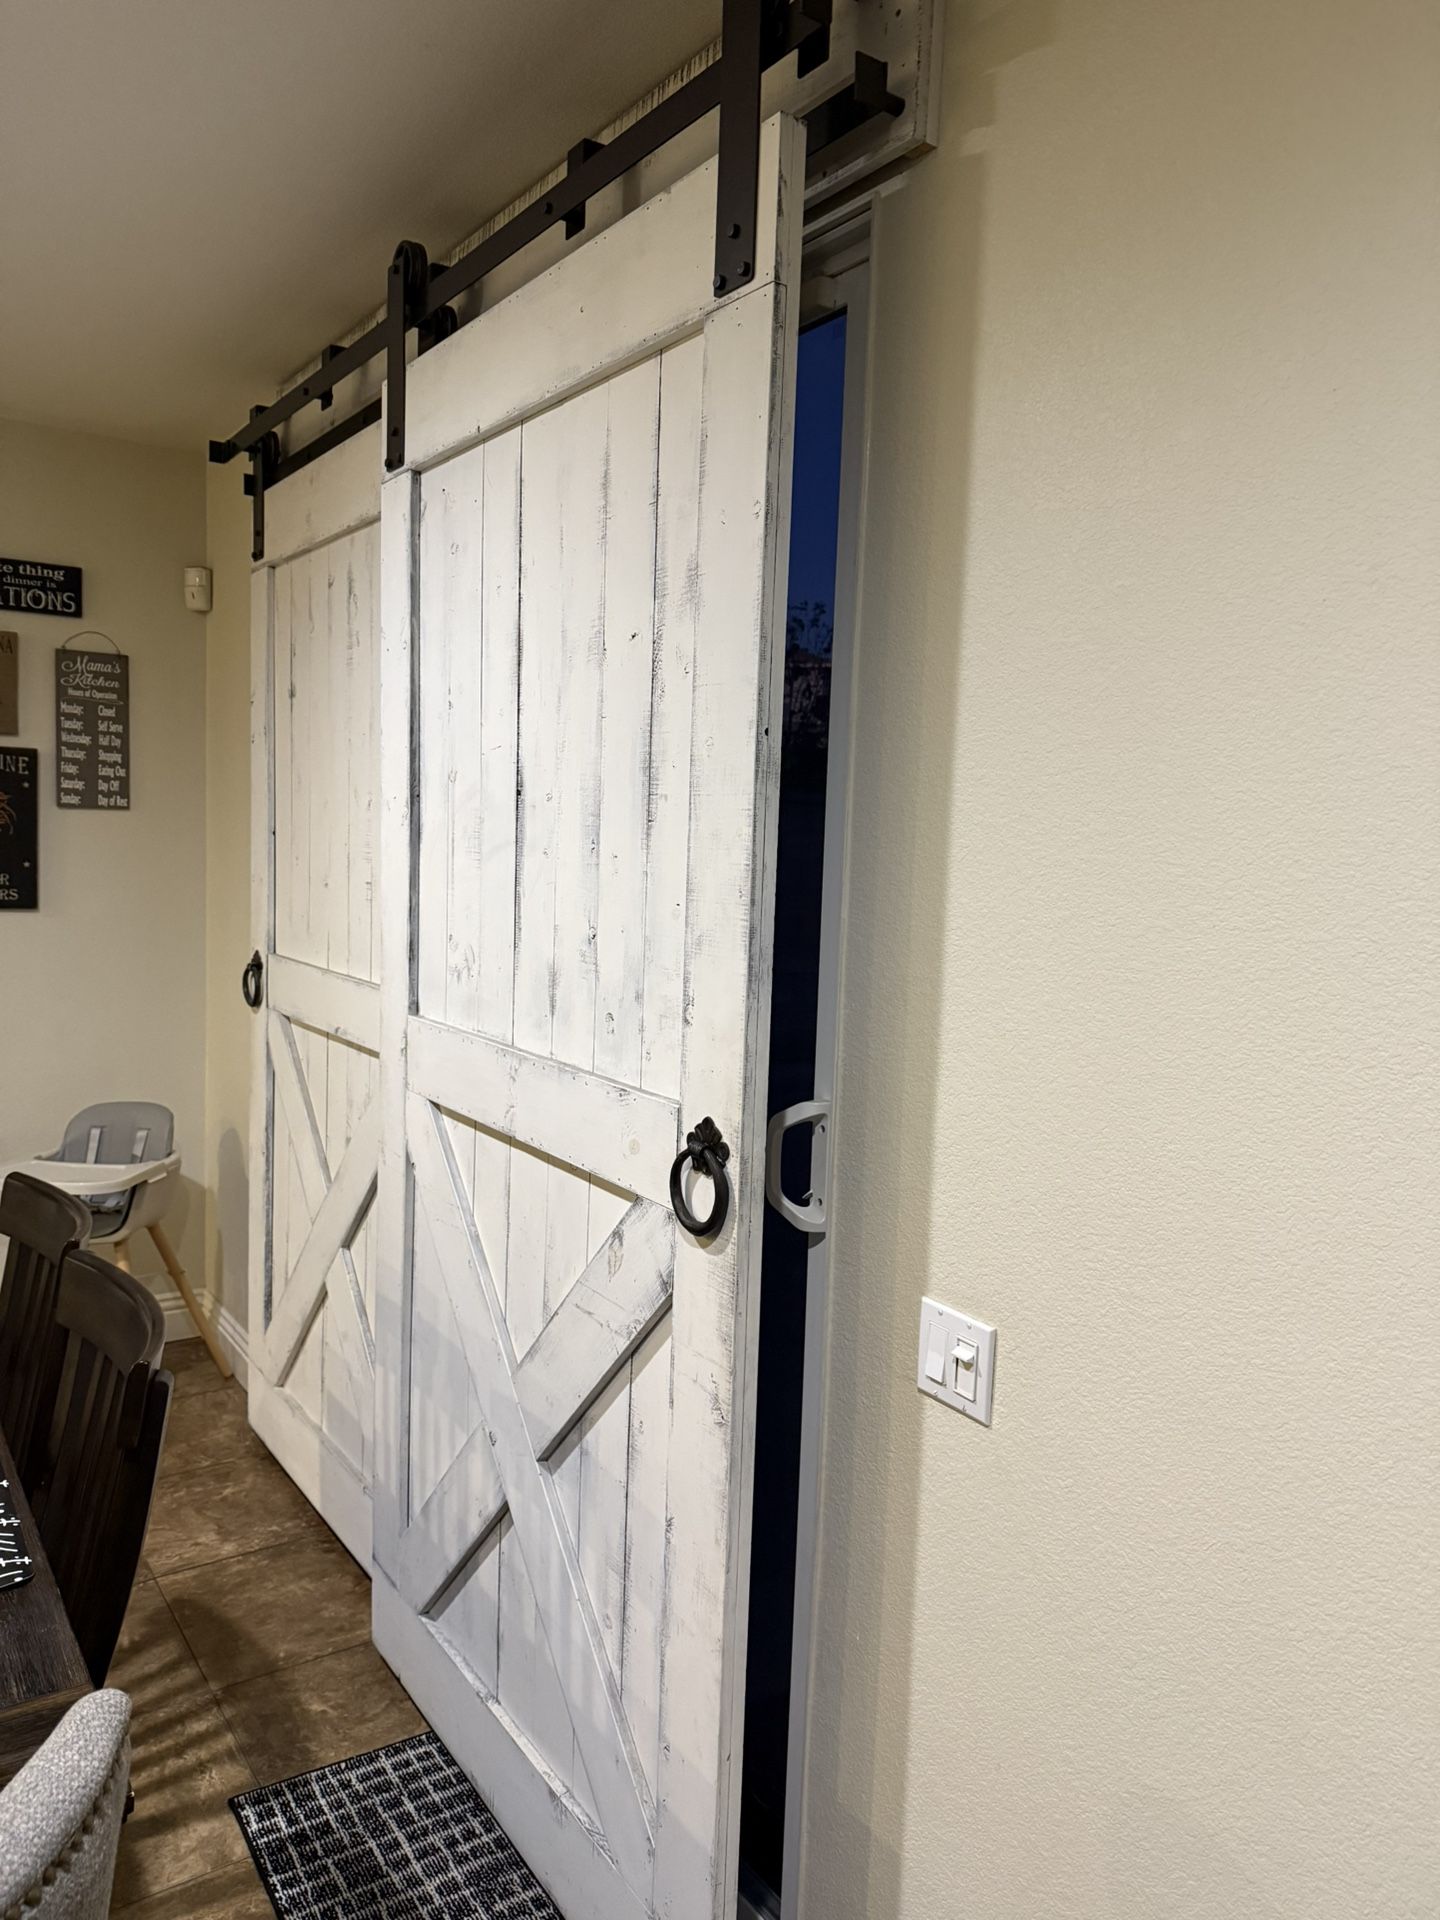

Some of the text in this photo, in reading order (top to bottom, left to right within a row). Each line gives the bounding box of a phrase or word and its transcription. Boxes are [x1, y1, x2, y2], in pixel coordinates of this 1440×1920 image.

[19, 564, 64, 580] thing
[3, 575, 57, 588] dinner is
[61, 655, 121, 676] Mama's
[60, 673, 120, 688] Kitchen
[92, 690, 118, 699] Operation
[60, 701, 84, 715] Monday:
[60, 717, 84, 731] Tuesday:
[61, 732, 92, 746] Wednesday:
[111, 735, 121, 748] Day
[61, 746, 87, 760] Thursday:
[61, 761, 80, 775] Friday:
[61, 776, 86, 791] Saturday:
[98, 779, 108, 792] Day
[61, 792, 81, 806] Sunday:
[98, 794, 108, 808] Day
